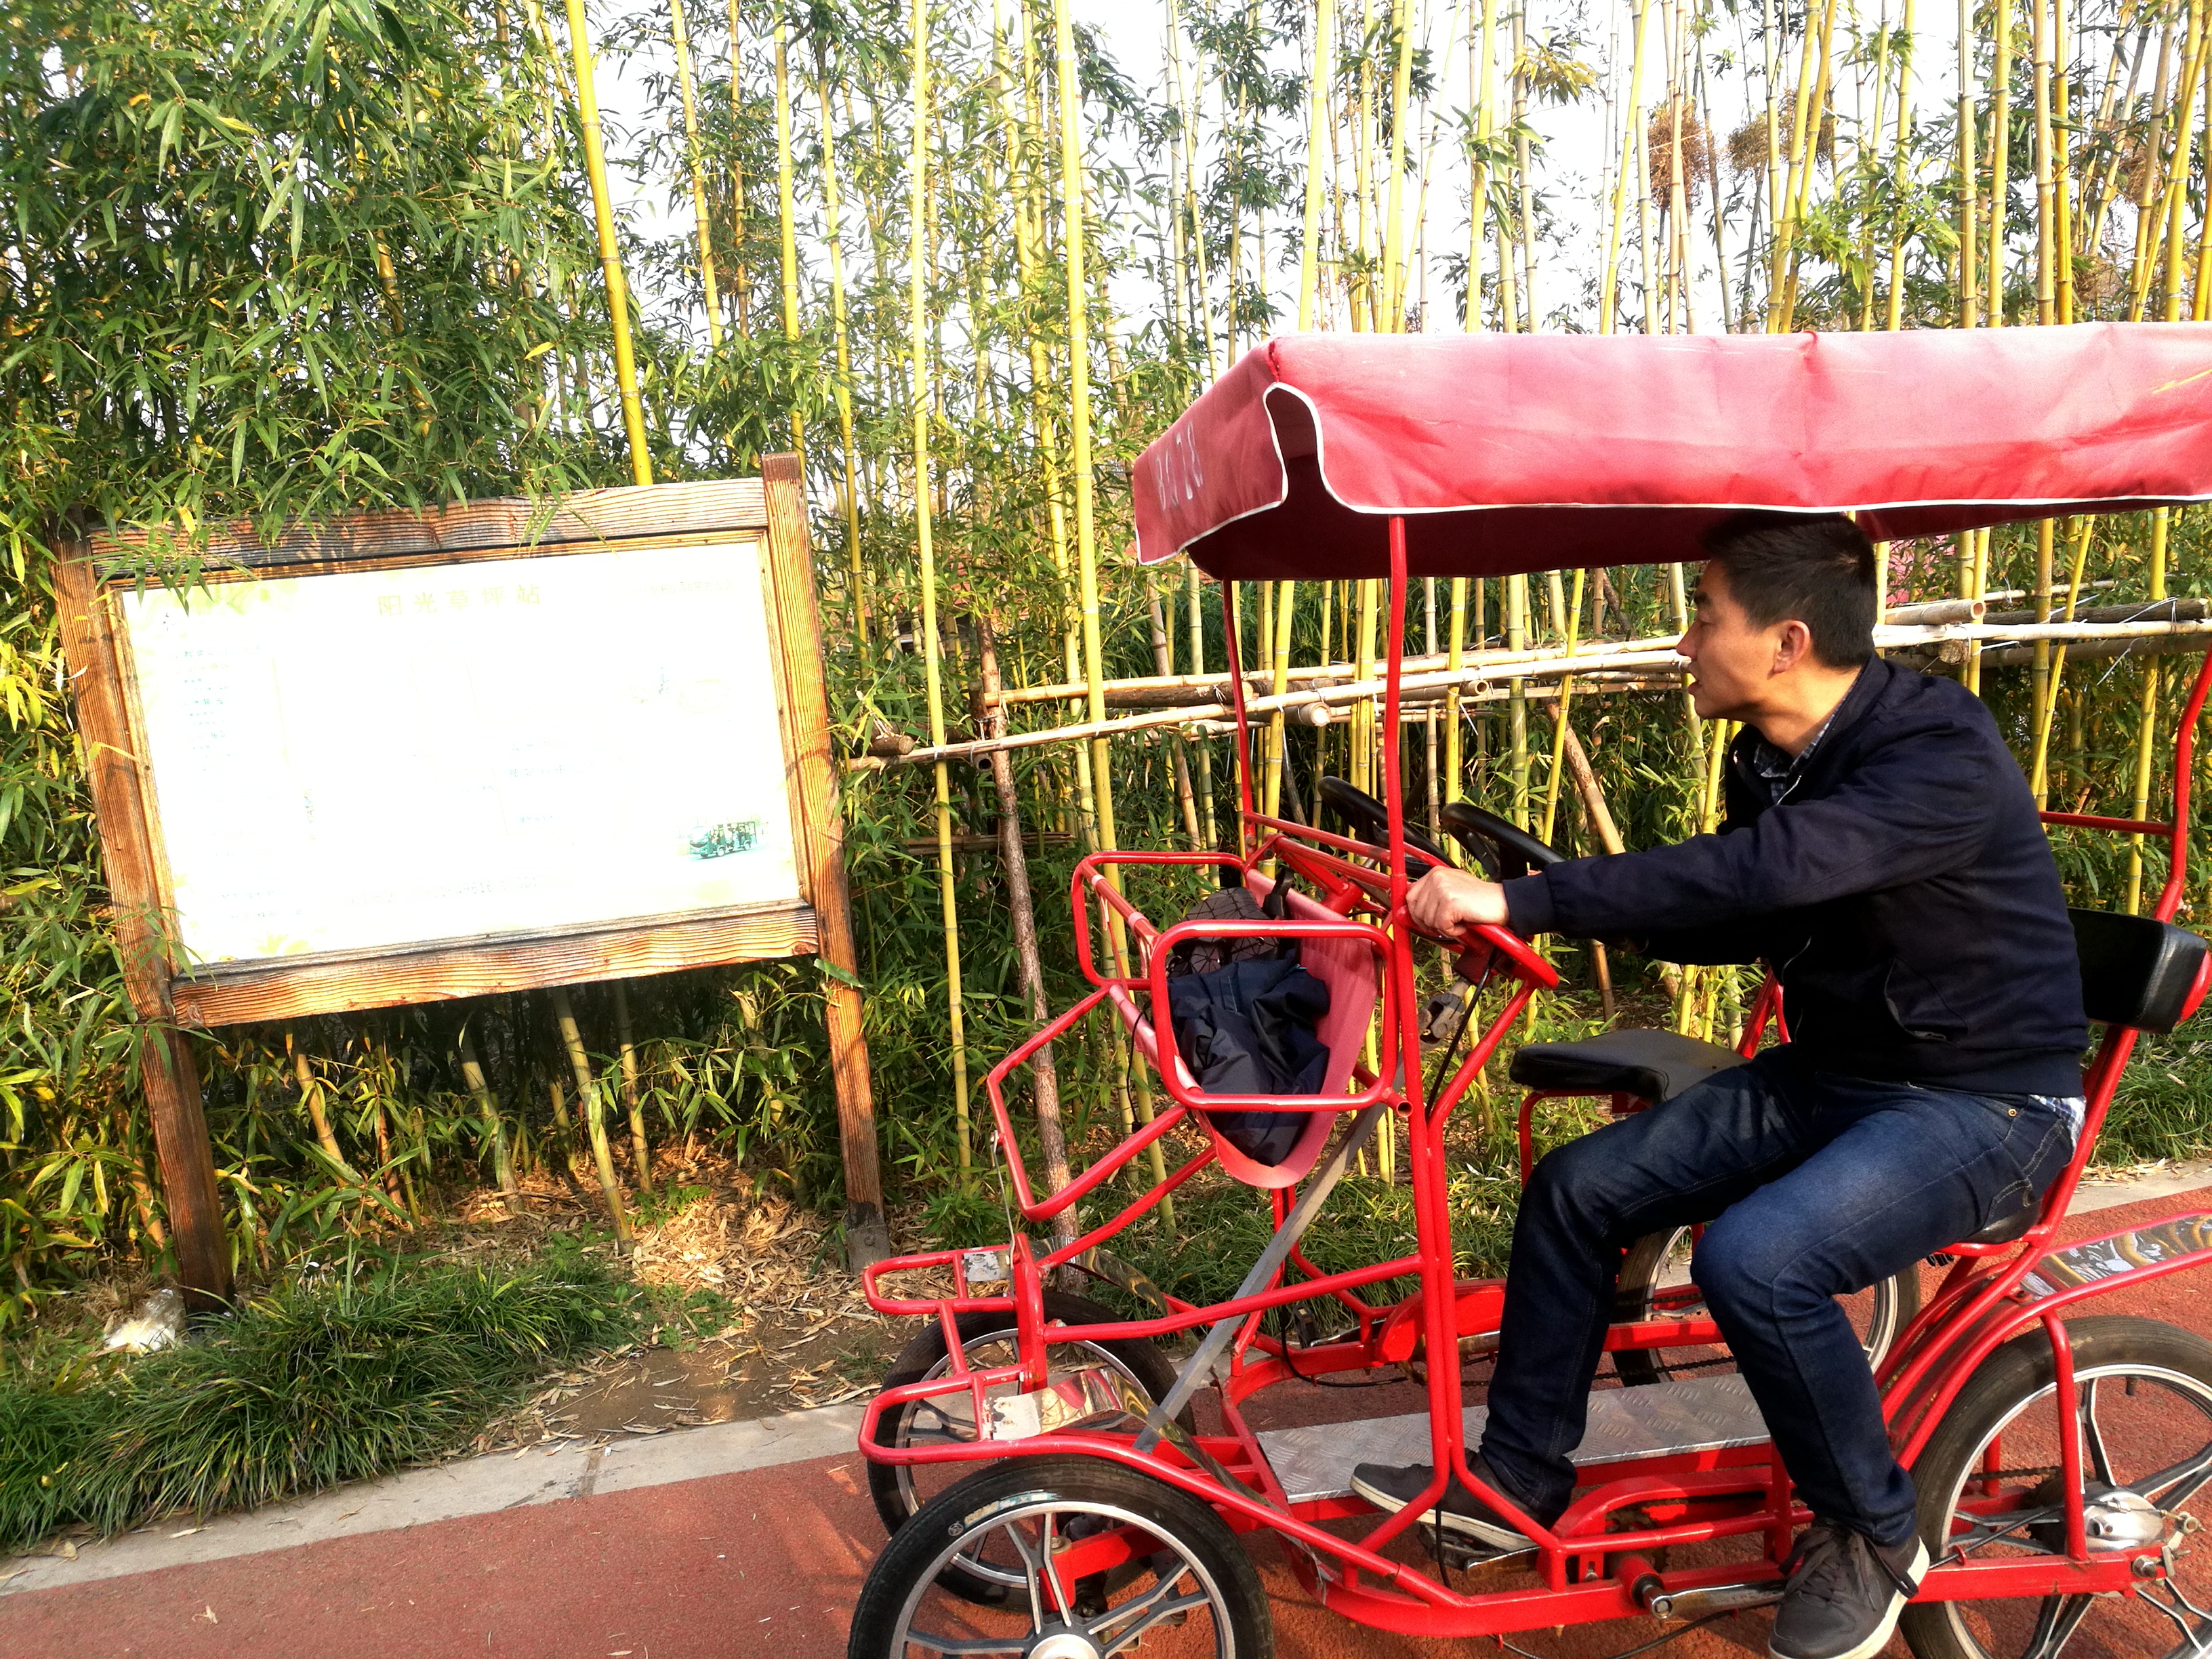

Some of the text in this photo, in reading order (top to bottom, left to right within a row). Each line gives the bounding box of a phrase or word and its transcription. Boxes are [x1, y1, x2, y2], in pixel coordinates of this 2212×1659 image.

[377, 583, 541, 617] 阳光草坪站
